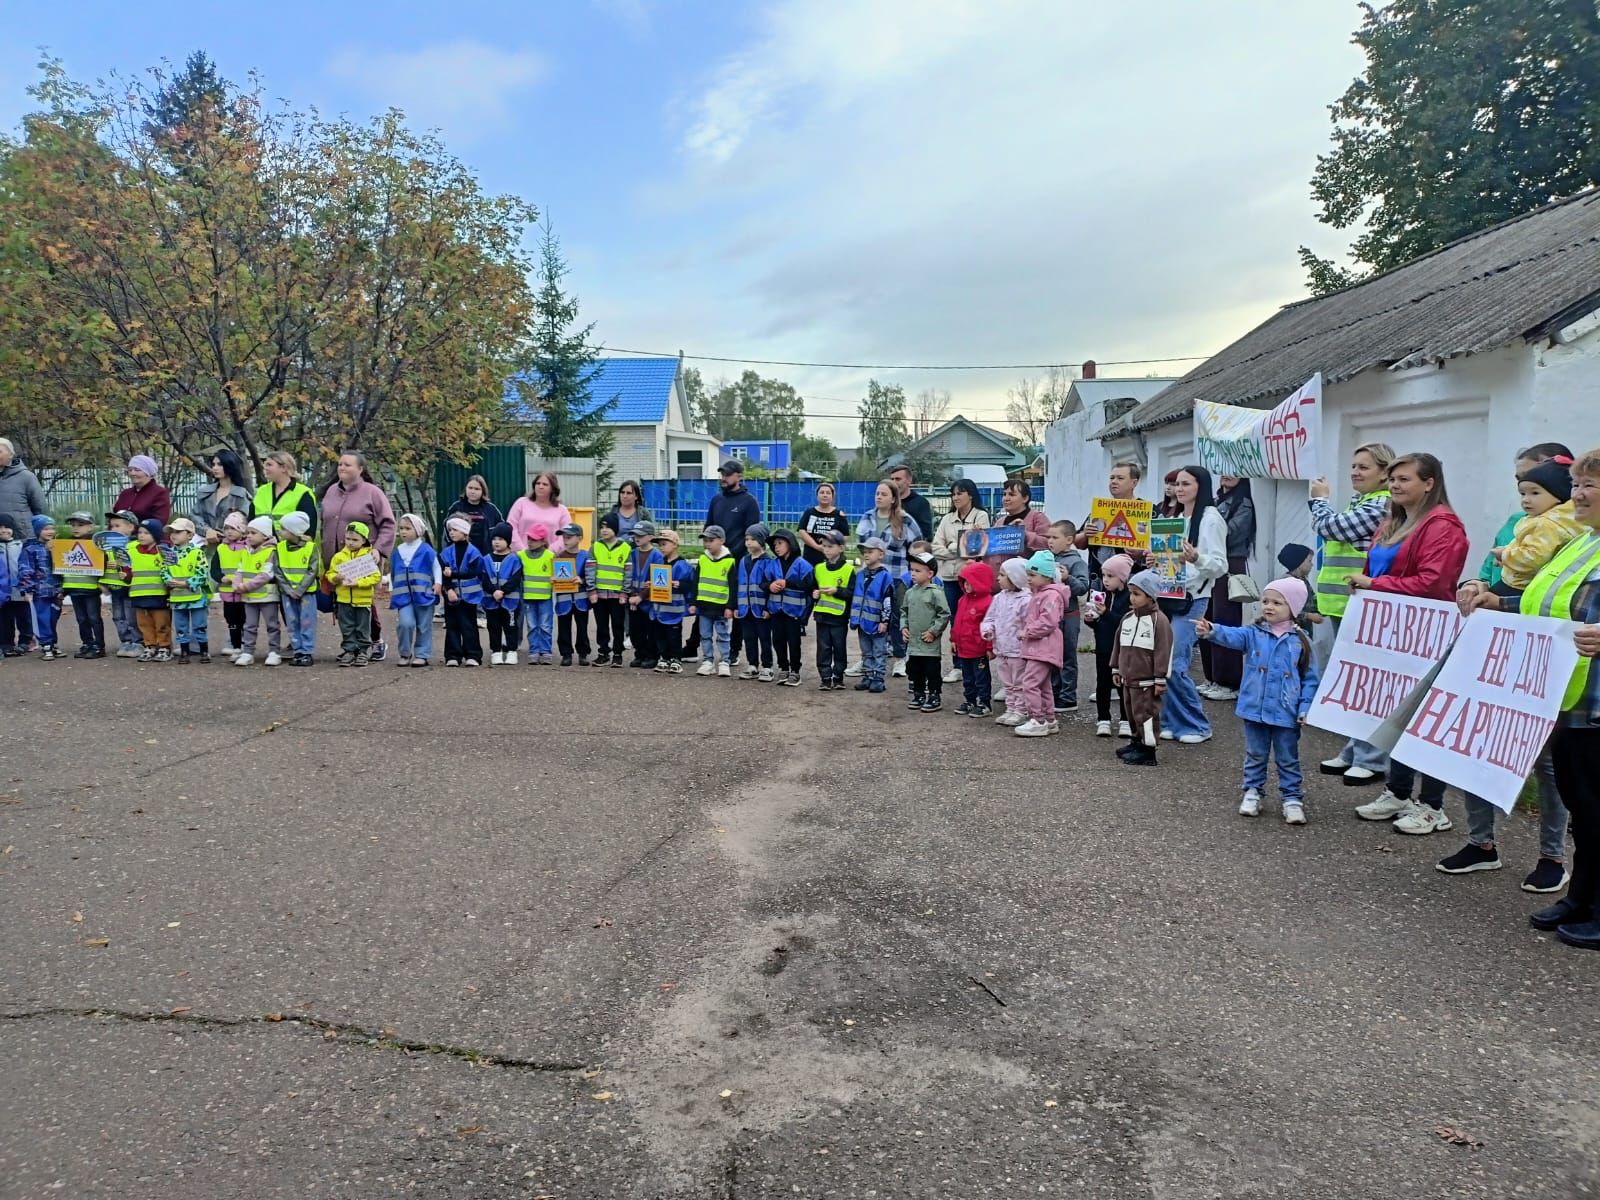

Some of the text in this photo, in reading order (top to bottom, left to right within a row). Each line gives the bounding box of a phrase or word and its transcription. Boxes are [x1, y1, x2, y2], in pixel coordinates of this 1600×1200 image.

[1097, 499, 1147, 510] ВНИМАНИЕ!
[1110, 508, 1150, 519] С ВАМИ
[1354, 597, 1460, 661] ПРАВИЛА
[1320, 659, 1421, 720] ДВИЖЕ
[1476, 626, 1553, 699] НЕ ДЛЯ
